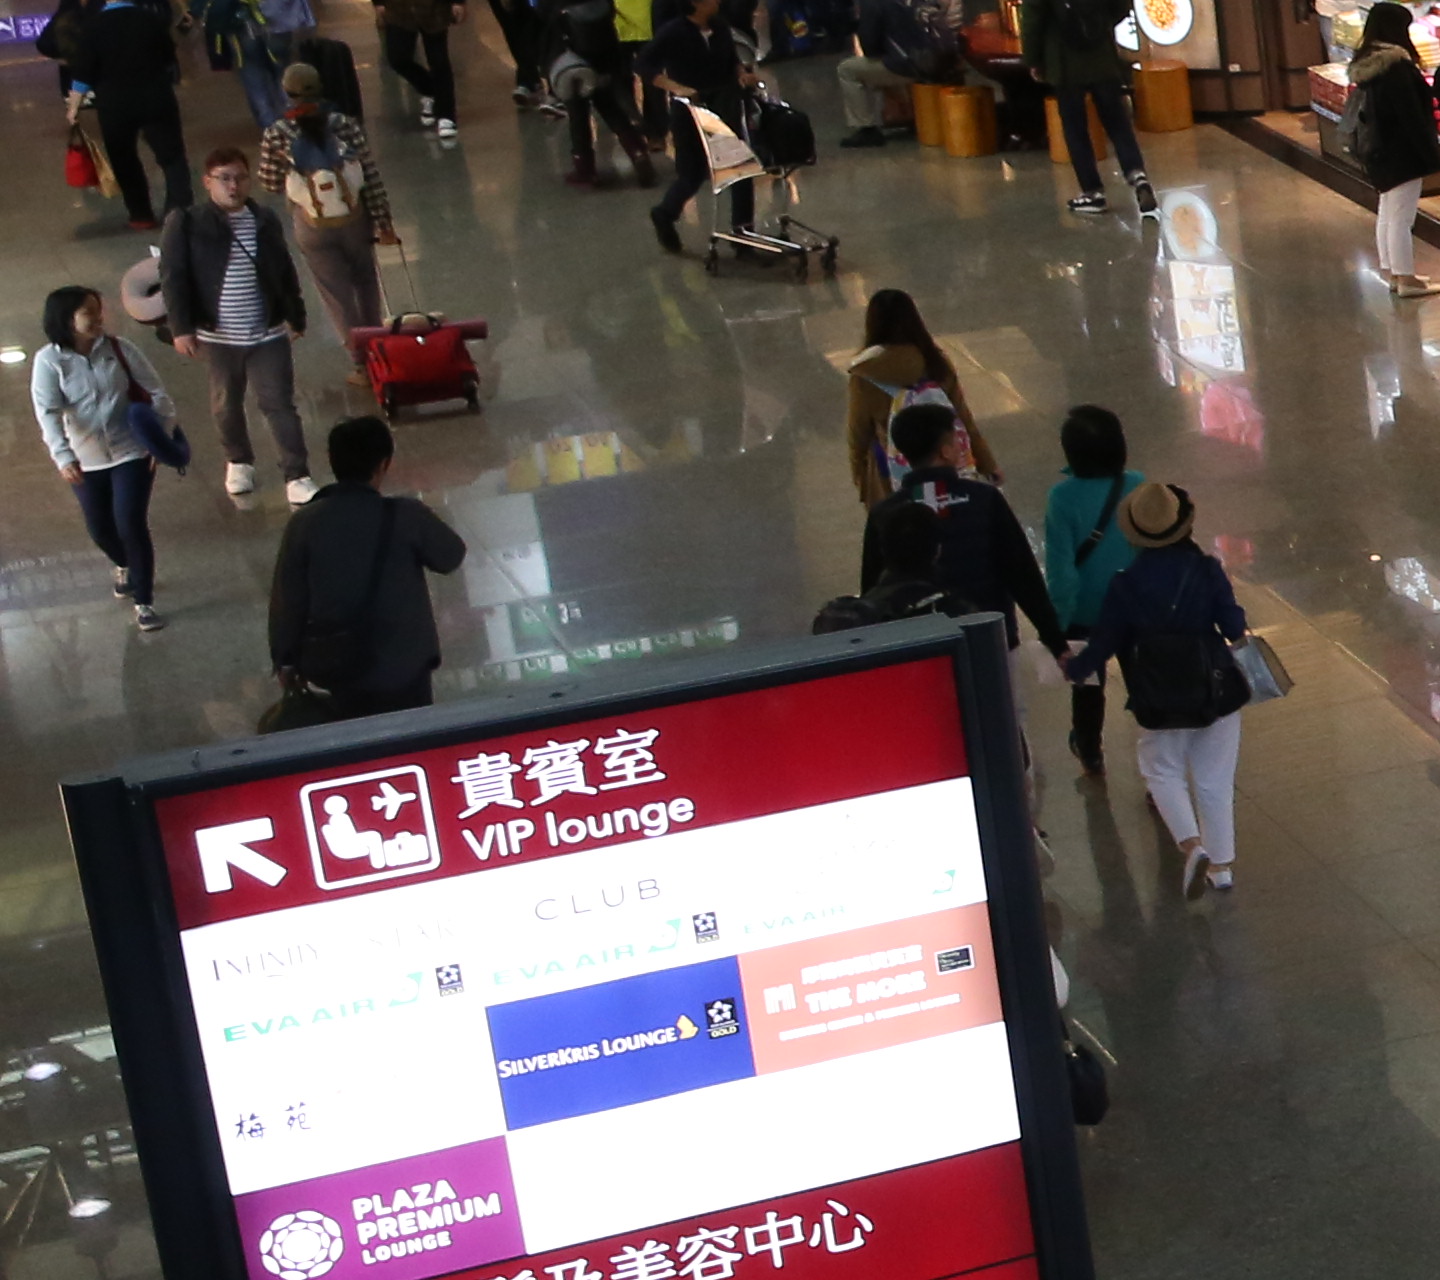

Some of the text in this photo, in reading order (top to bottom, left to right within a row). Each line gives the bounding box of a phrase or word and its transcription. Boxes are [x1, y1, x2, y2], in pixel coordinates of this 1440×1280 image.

[451, 728, 666, 820] 貴賓室
[461, 794, 696, 862] VIP lounge
[534, 878, 661, 922] CLUB
[493, 942, 635, 986] EVA AIR
[222, 998, 377, 1043] EVA AIR
[352, 1178, 457, 1220] PLAZA
[357, 1191, 501, 1246] PREMIUM
[361, 1229, 452, 1267] LOUNGE
